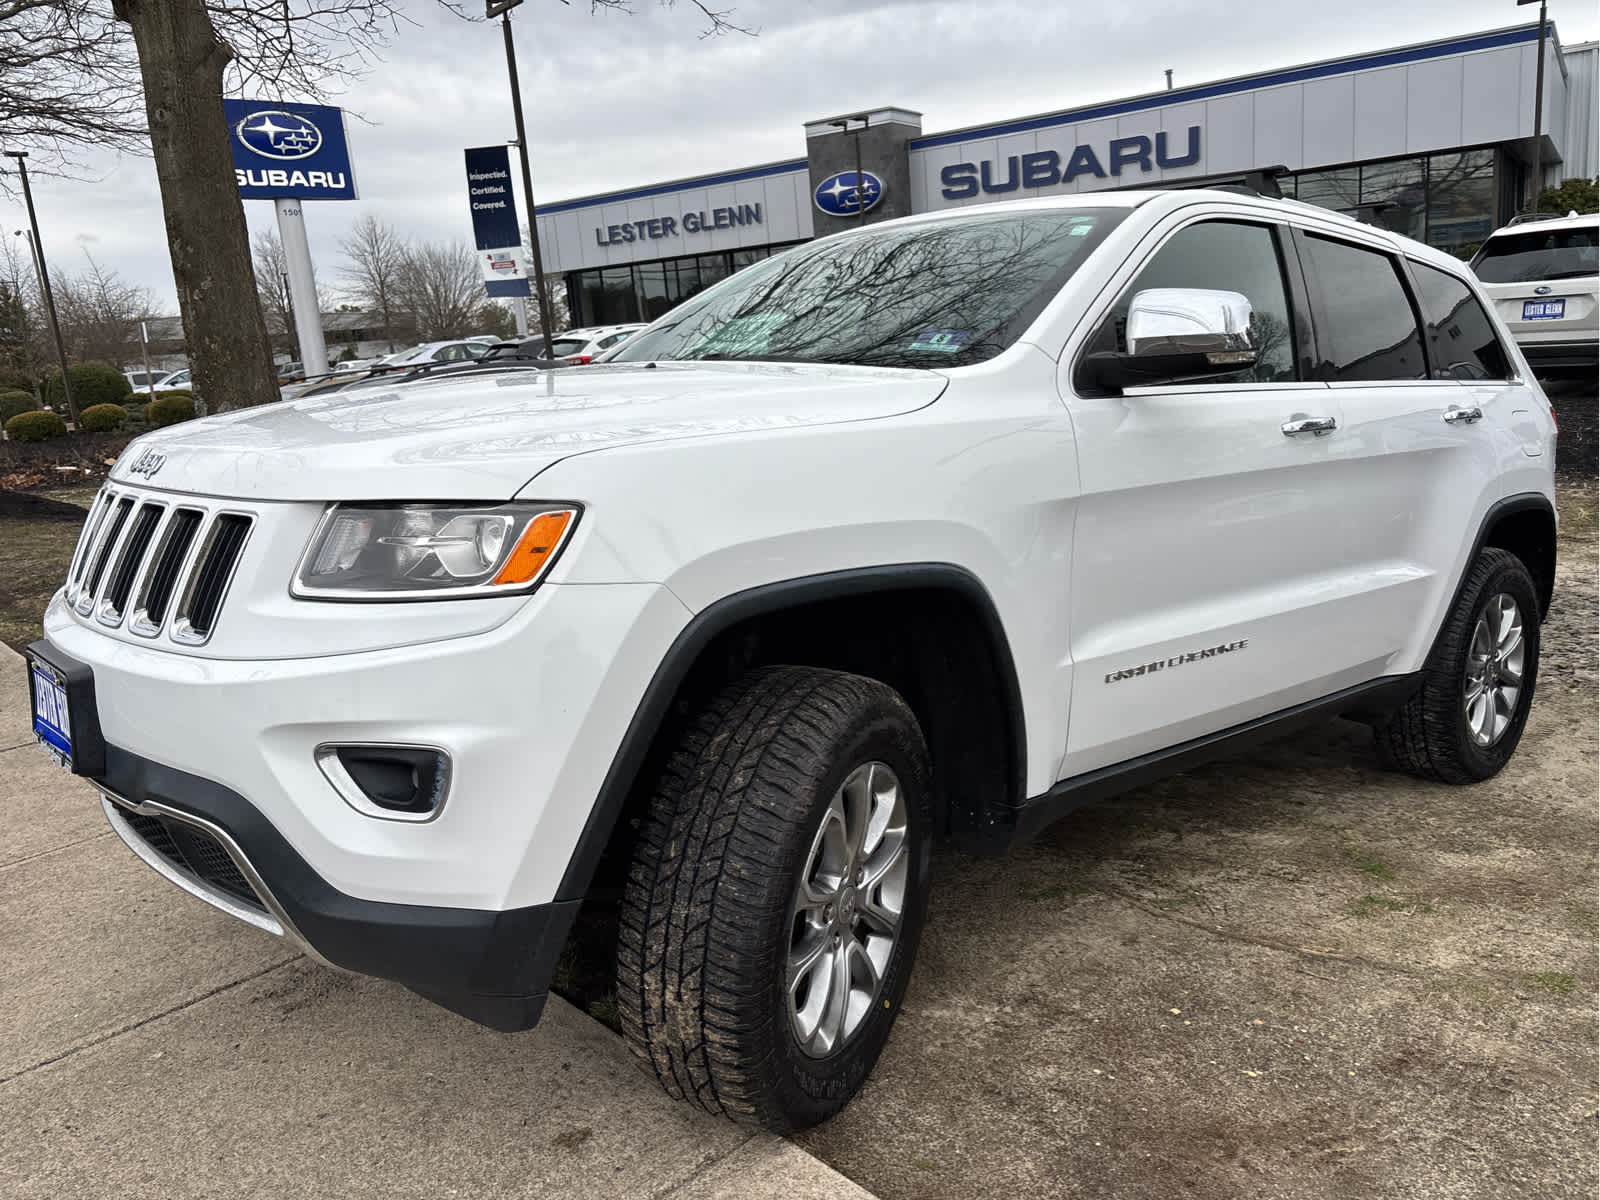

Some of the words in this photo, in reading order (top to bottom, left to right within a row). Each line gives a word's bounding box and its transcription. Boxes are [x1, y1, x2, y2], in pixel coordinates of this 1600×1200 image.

[940, 126, 1201, 201] SUBARU
[235, 169, 345, 188] SUBARU
[469, 170, 508, 181] Inspected.
[471, 185, 506, 195] Certified.
[473, 200, 507, 210] Covered.
[596, 216, 678, 247] LESTER
[682, 203, 762, 234] GLENN
[1525, 304, 1544, 315] LESTER
[1545, 303, 1562, 314] GLENN
[130, 448, 167, 480] Jeep
[1104, 660, 1165, 684] GRAND
[1167, 639, 1249, 667] CHEROKEE
